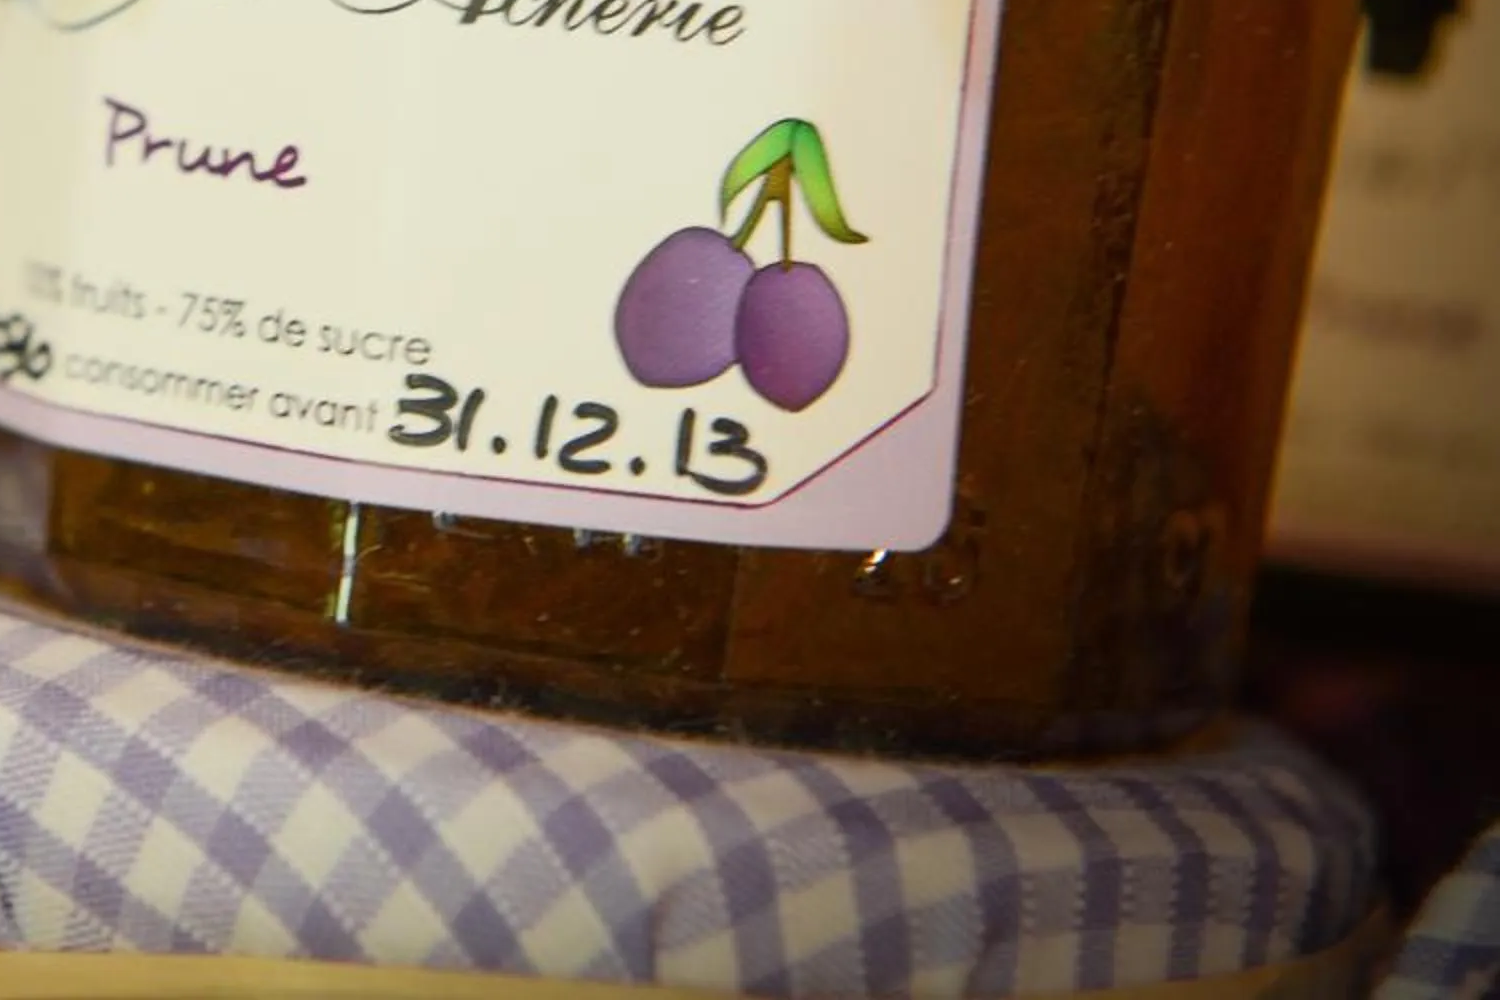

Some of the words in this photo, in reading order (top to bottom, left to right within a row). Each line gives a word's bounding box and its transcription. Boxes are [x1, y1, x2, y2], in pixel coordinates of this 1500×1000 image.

[102, 96, 308, 189] Prune
[177, 291, 248, 339] 75%
[257, 306, 308, 349] de
[316, 322, 434, 367] sucre
[64, 352, 260, 412] consommer
[267, 391, 380, 435] avant
